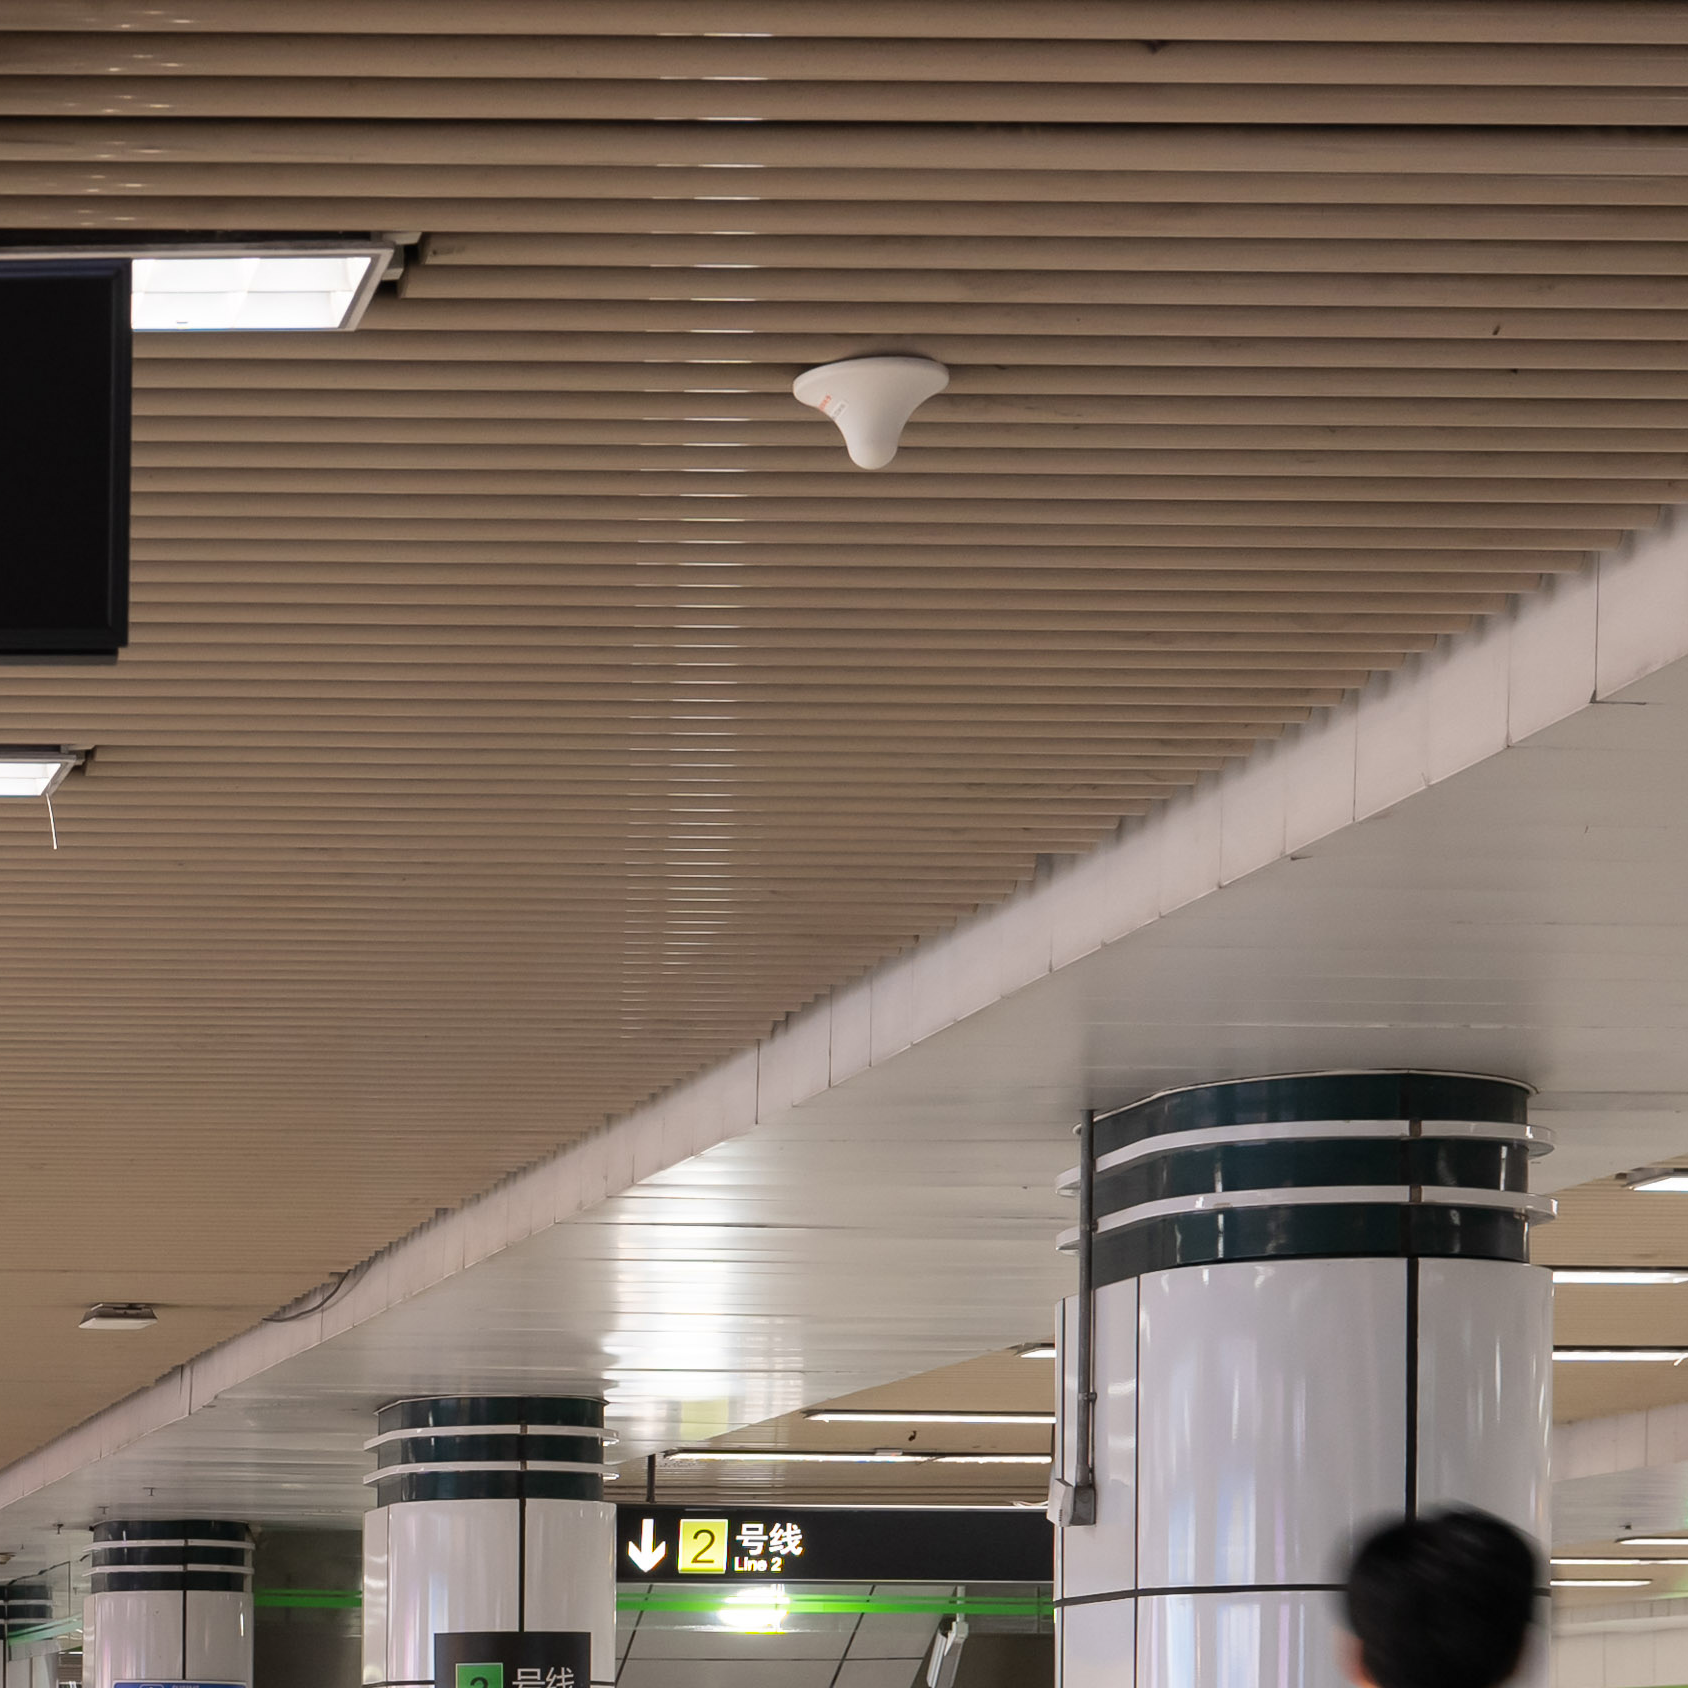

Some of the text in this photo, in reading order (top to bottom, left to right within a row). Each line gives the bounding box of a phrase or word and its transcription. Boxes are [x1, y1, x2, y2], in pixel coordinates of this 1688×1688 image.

[692, 1522, 804, 1564] 2 号线
[734, 1557, 782, 1572] Line 2
